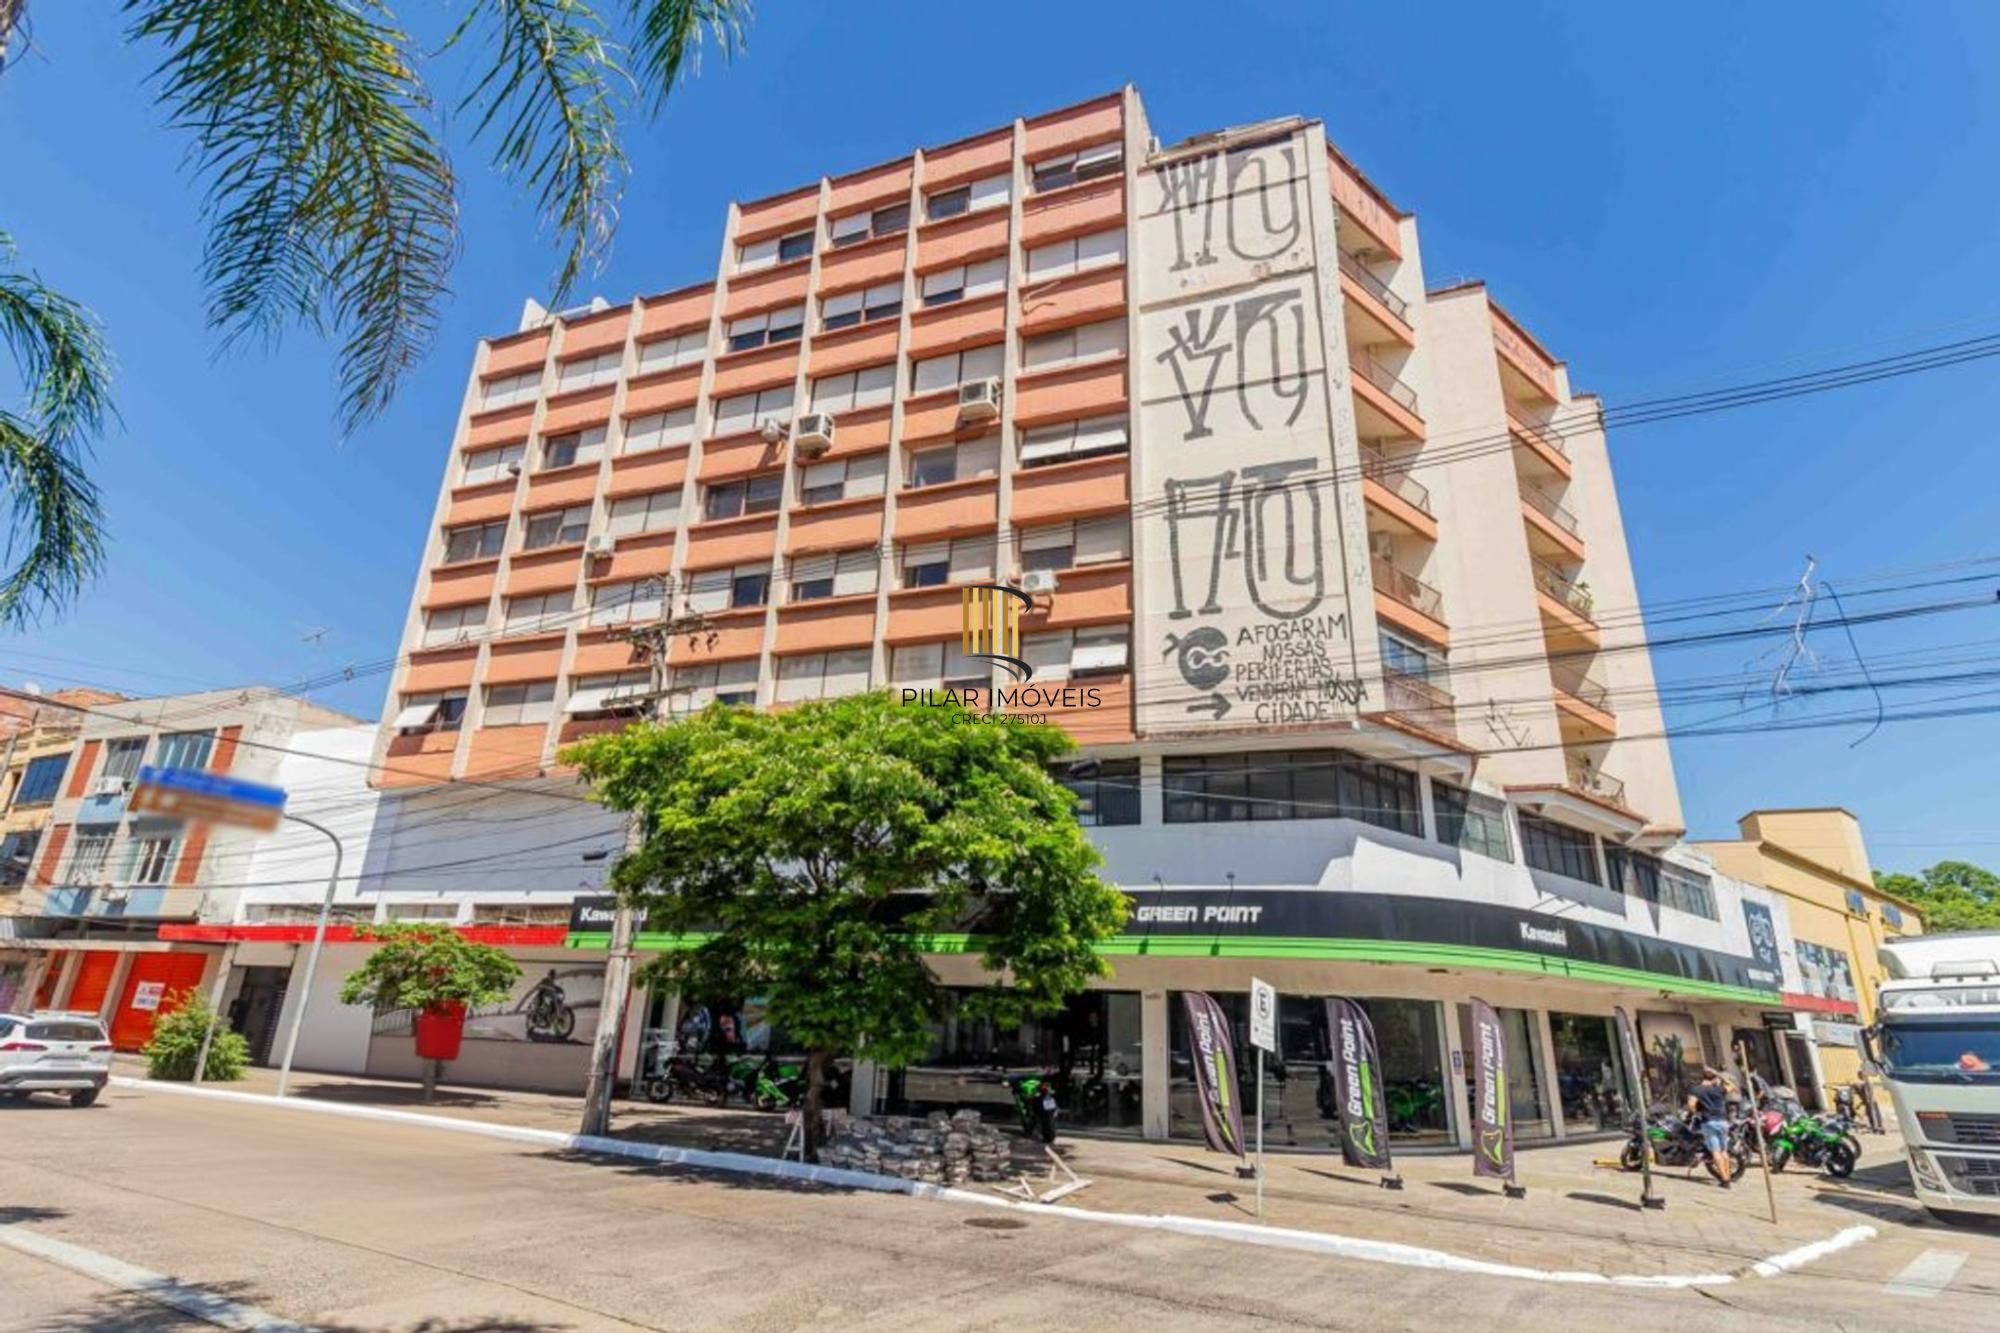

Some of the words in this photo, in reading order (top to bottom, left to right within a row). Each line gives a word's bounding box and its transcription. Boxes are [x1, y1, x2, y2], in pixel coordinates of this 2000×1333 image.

[1236, 613, 1347, 646] AFOGARAM
[1263, 639, 1327, 661] NOSSAS
[1137, 905, 1199, 922] GREEN
[1203, 905, 1263, 922] POINT
[1340, 1018, 1357, 1064] Point
[1479, 1021, 1495, 1067] Point
[1347, 1065, 1363, 1117] Green
[1482, 1069, 1496, 1125] Green
